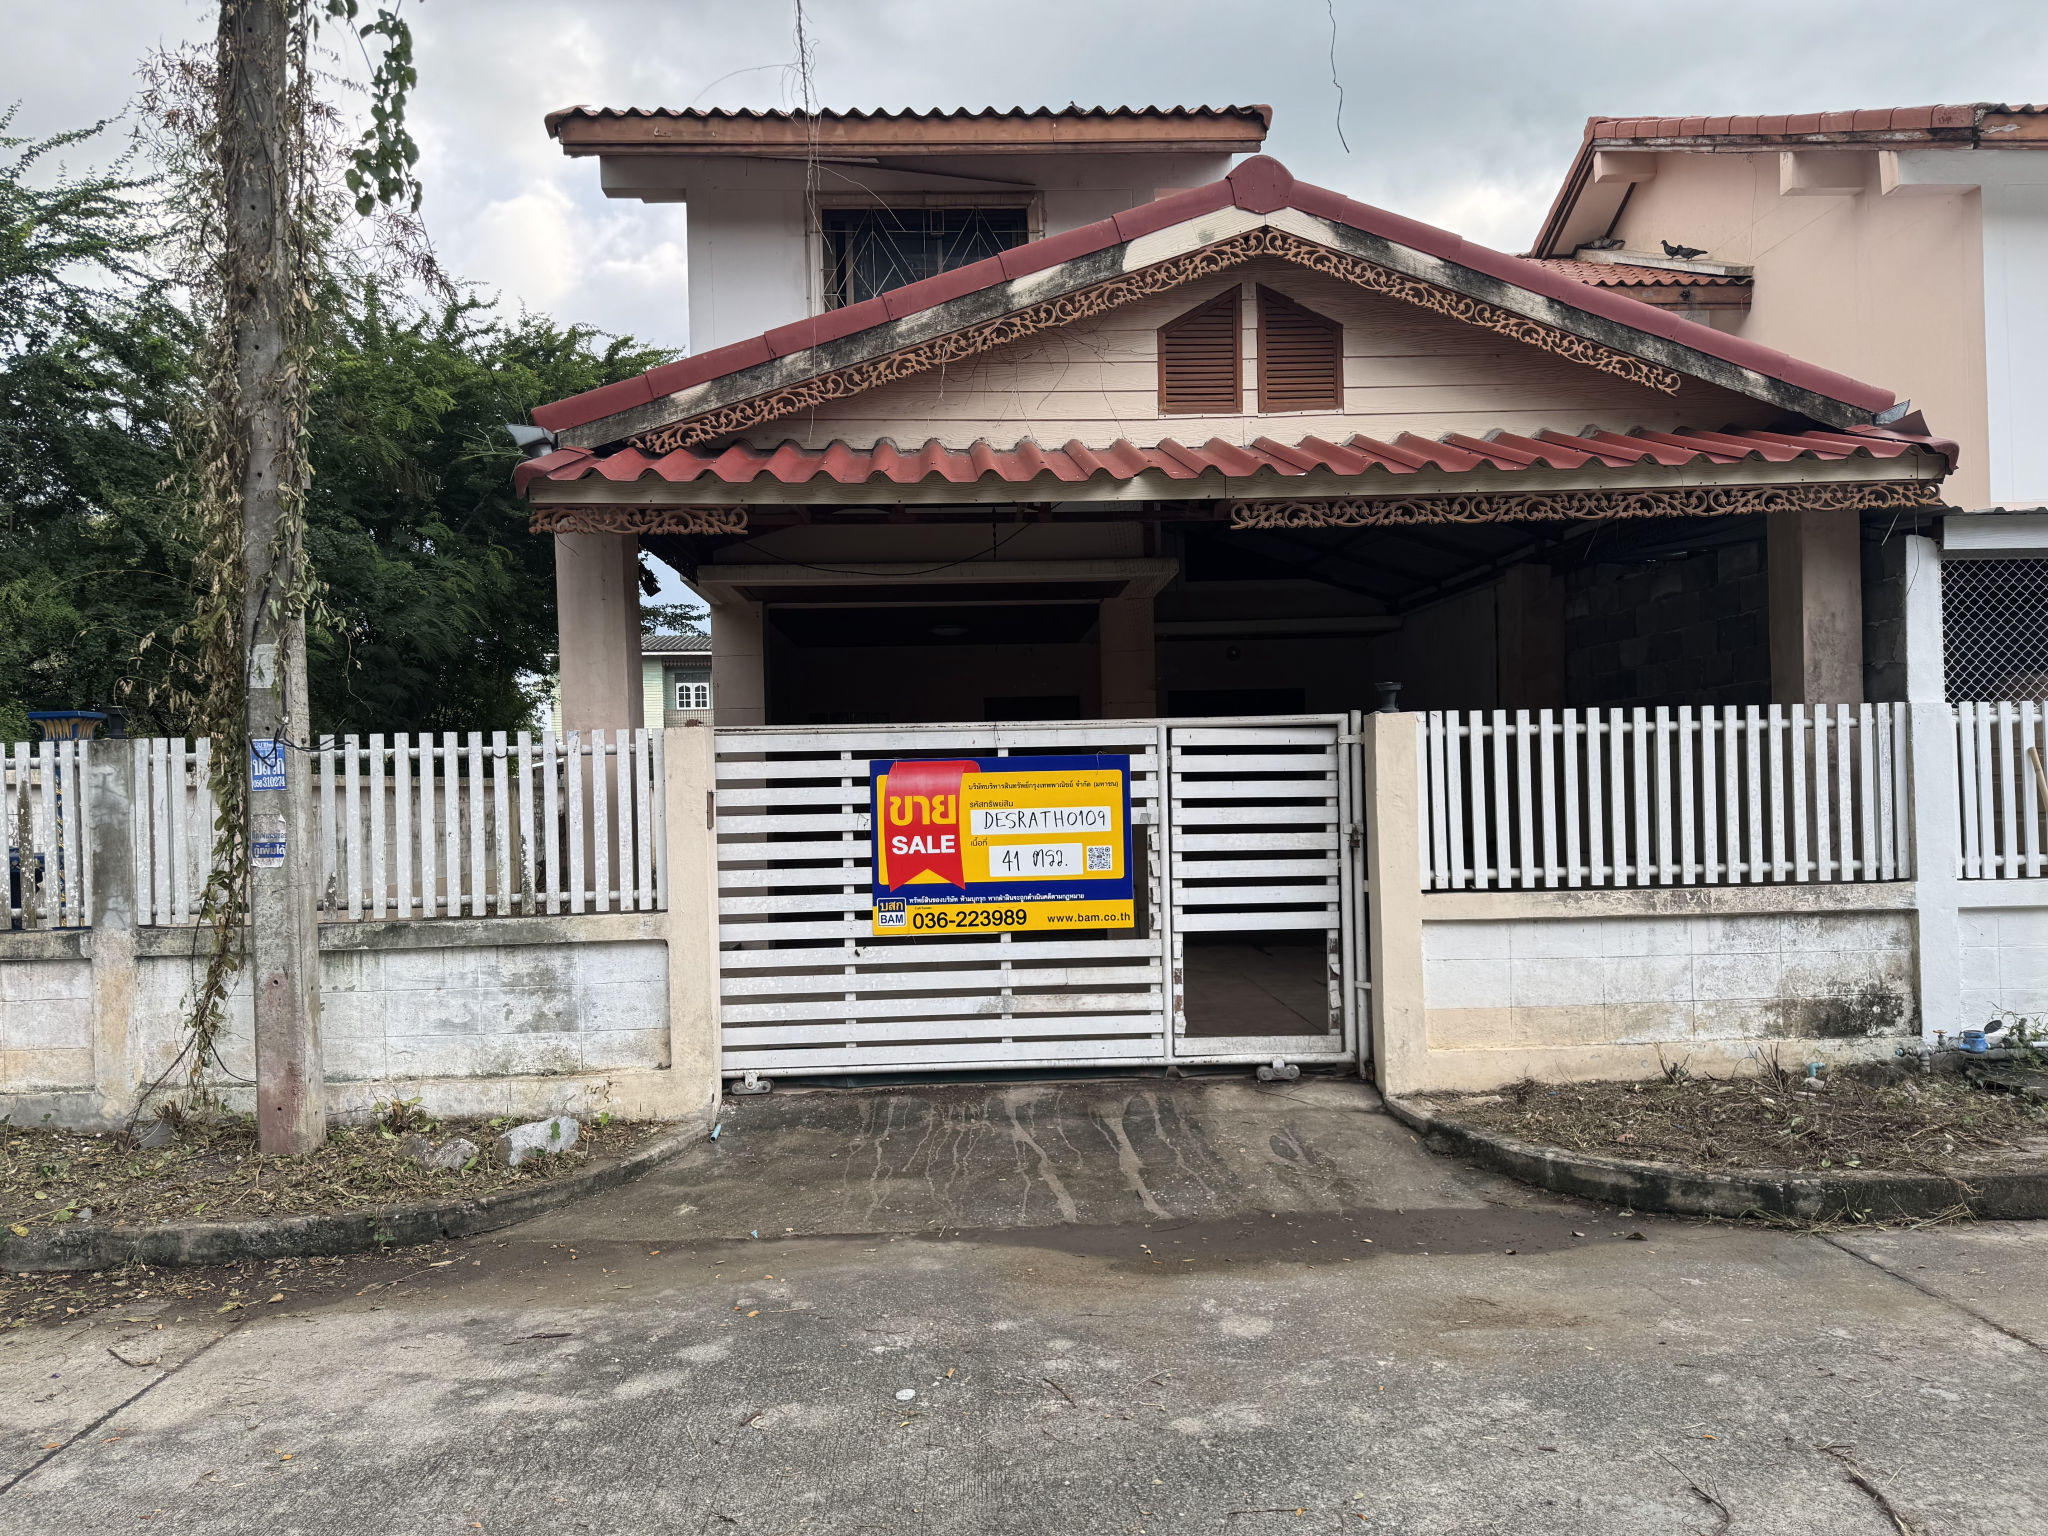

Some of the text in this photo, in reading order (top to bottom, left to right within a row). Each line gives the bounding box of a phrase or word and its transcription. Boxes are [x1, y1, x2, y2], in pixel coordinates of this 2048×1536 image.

[969, 799, 1014, 808] รหัสทรัพย์สิน
[889, 794, 957, 827] ขาย
[891, 834, 956, 855] SALE
[970, 836, 988, 847] เนื้อที่
[880, 901, 904, 912] บสก
[880, 914, 904, 924] BAM
[912, 910, 1027, 929] 036-223989
[1047, 912, 1131, 923] www.bam.co.th
